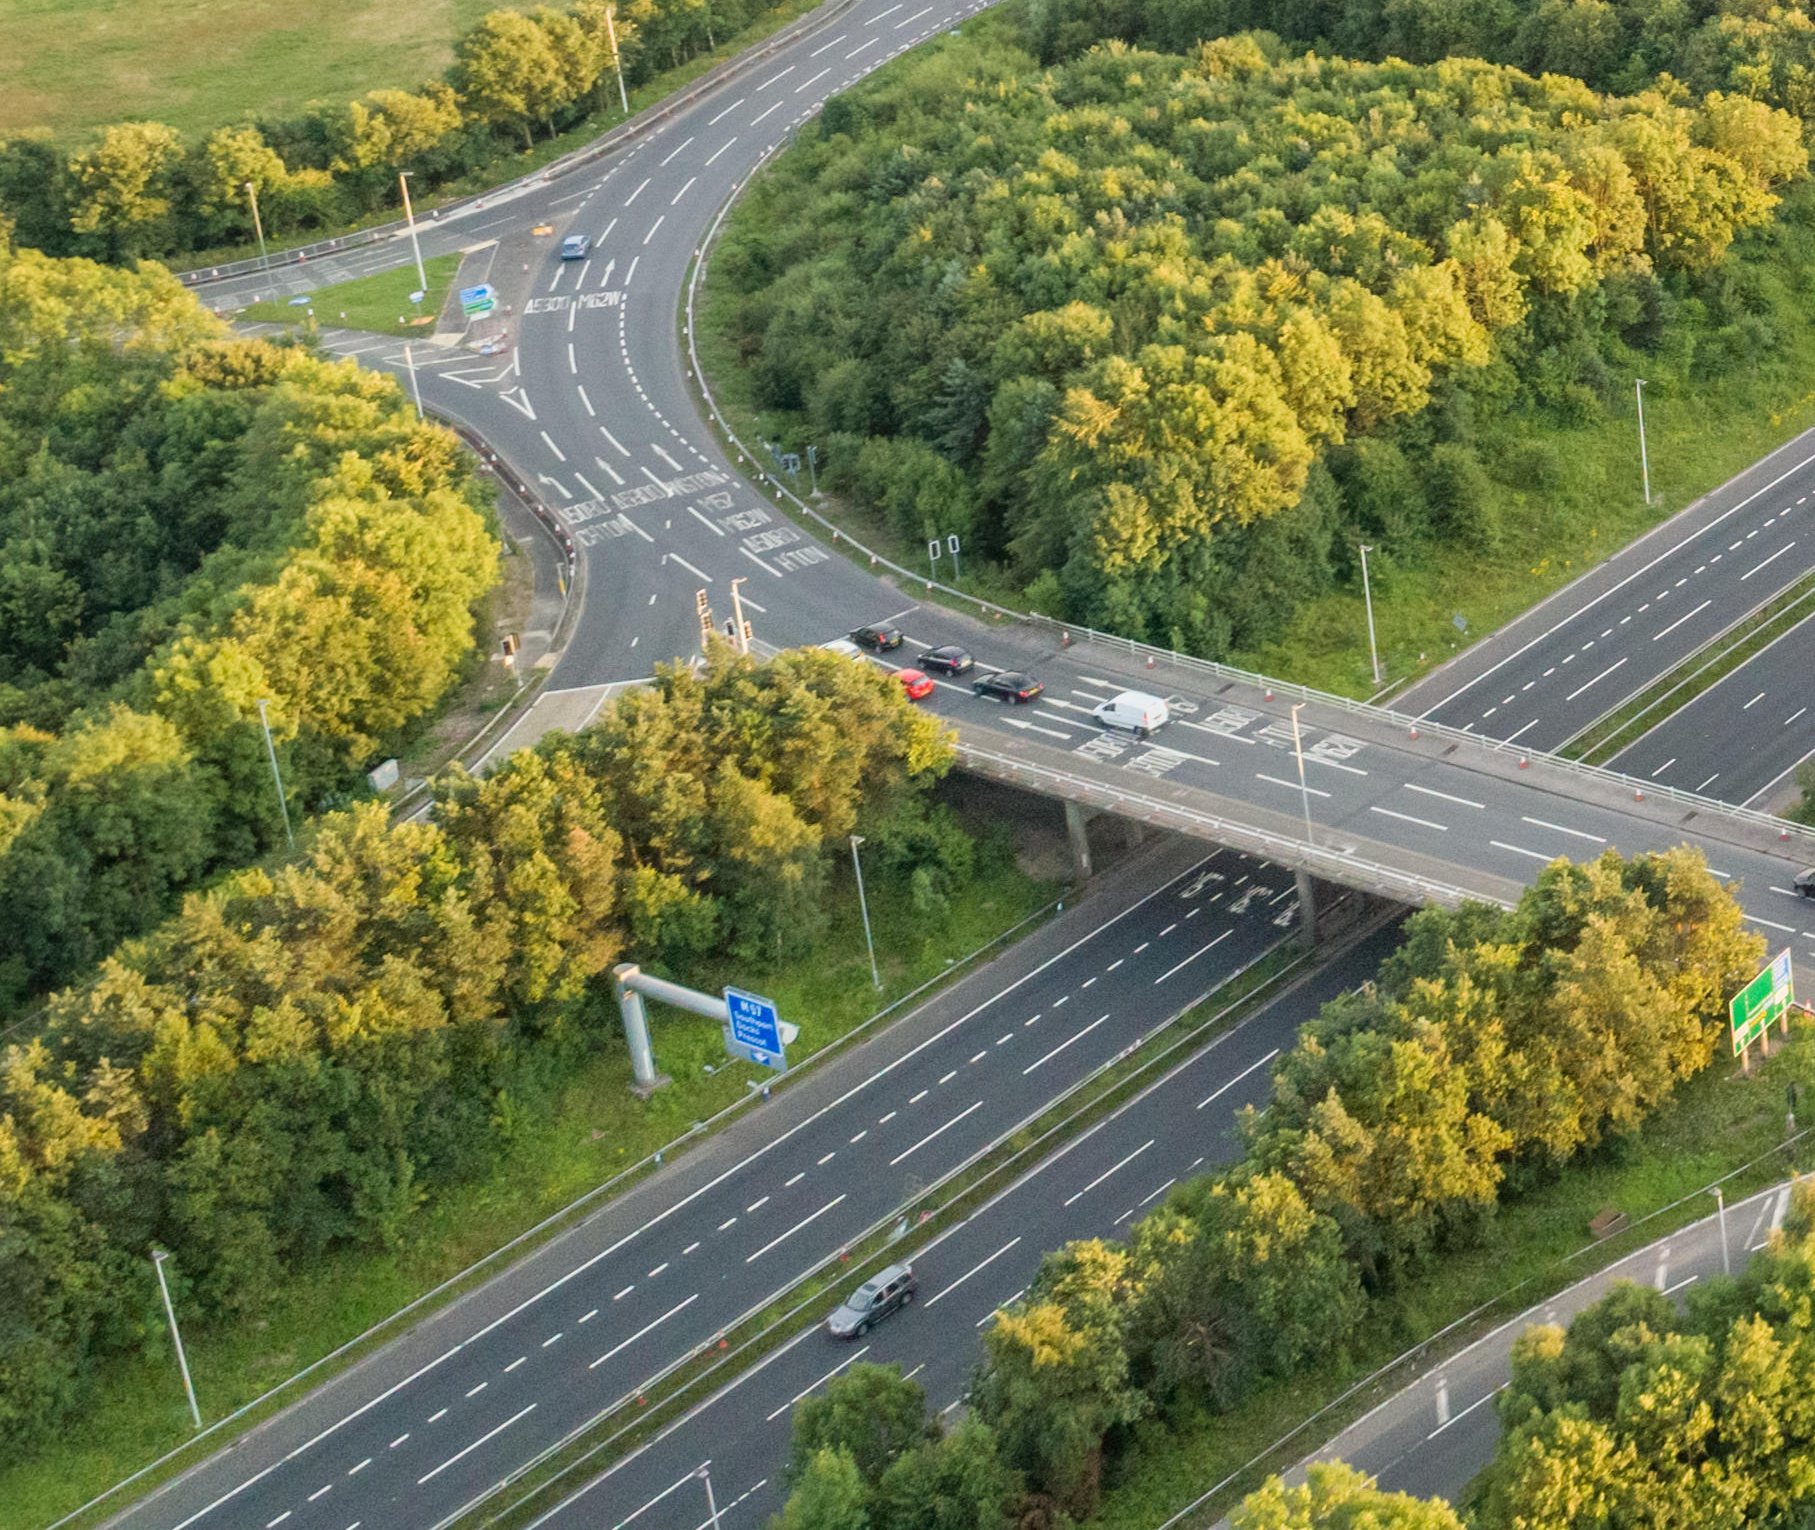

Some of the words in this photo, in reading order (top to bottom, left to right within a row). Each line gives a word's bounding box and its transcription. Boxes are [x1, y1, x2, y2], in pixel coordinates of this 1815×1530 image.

[523, 294, 572, 315] A5300
[578, 290, 621, 309] M62W
[610, 483, 666, 510] A5300
[717, 508, 772, 533] M62W
[741, 1000, 762, 1017] M57
